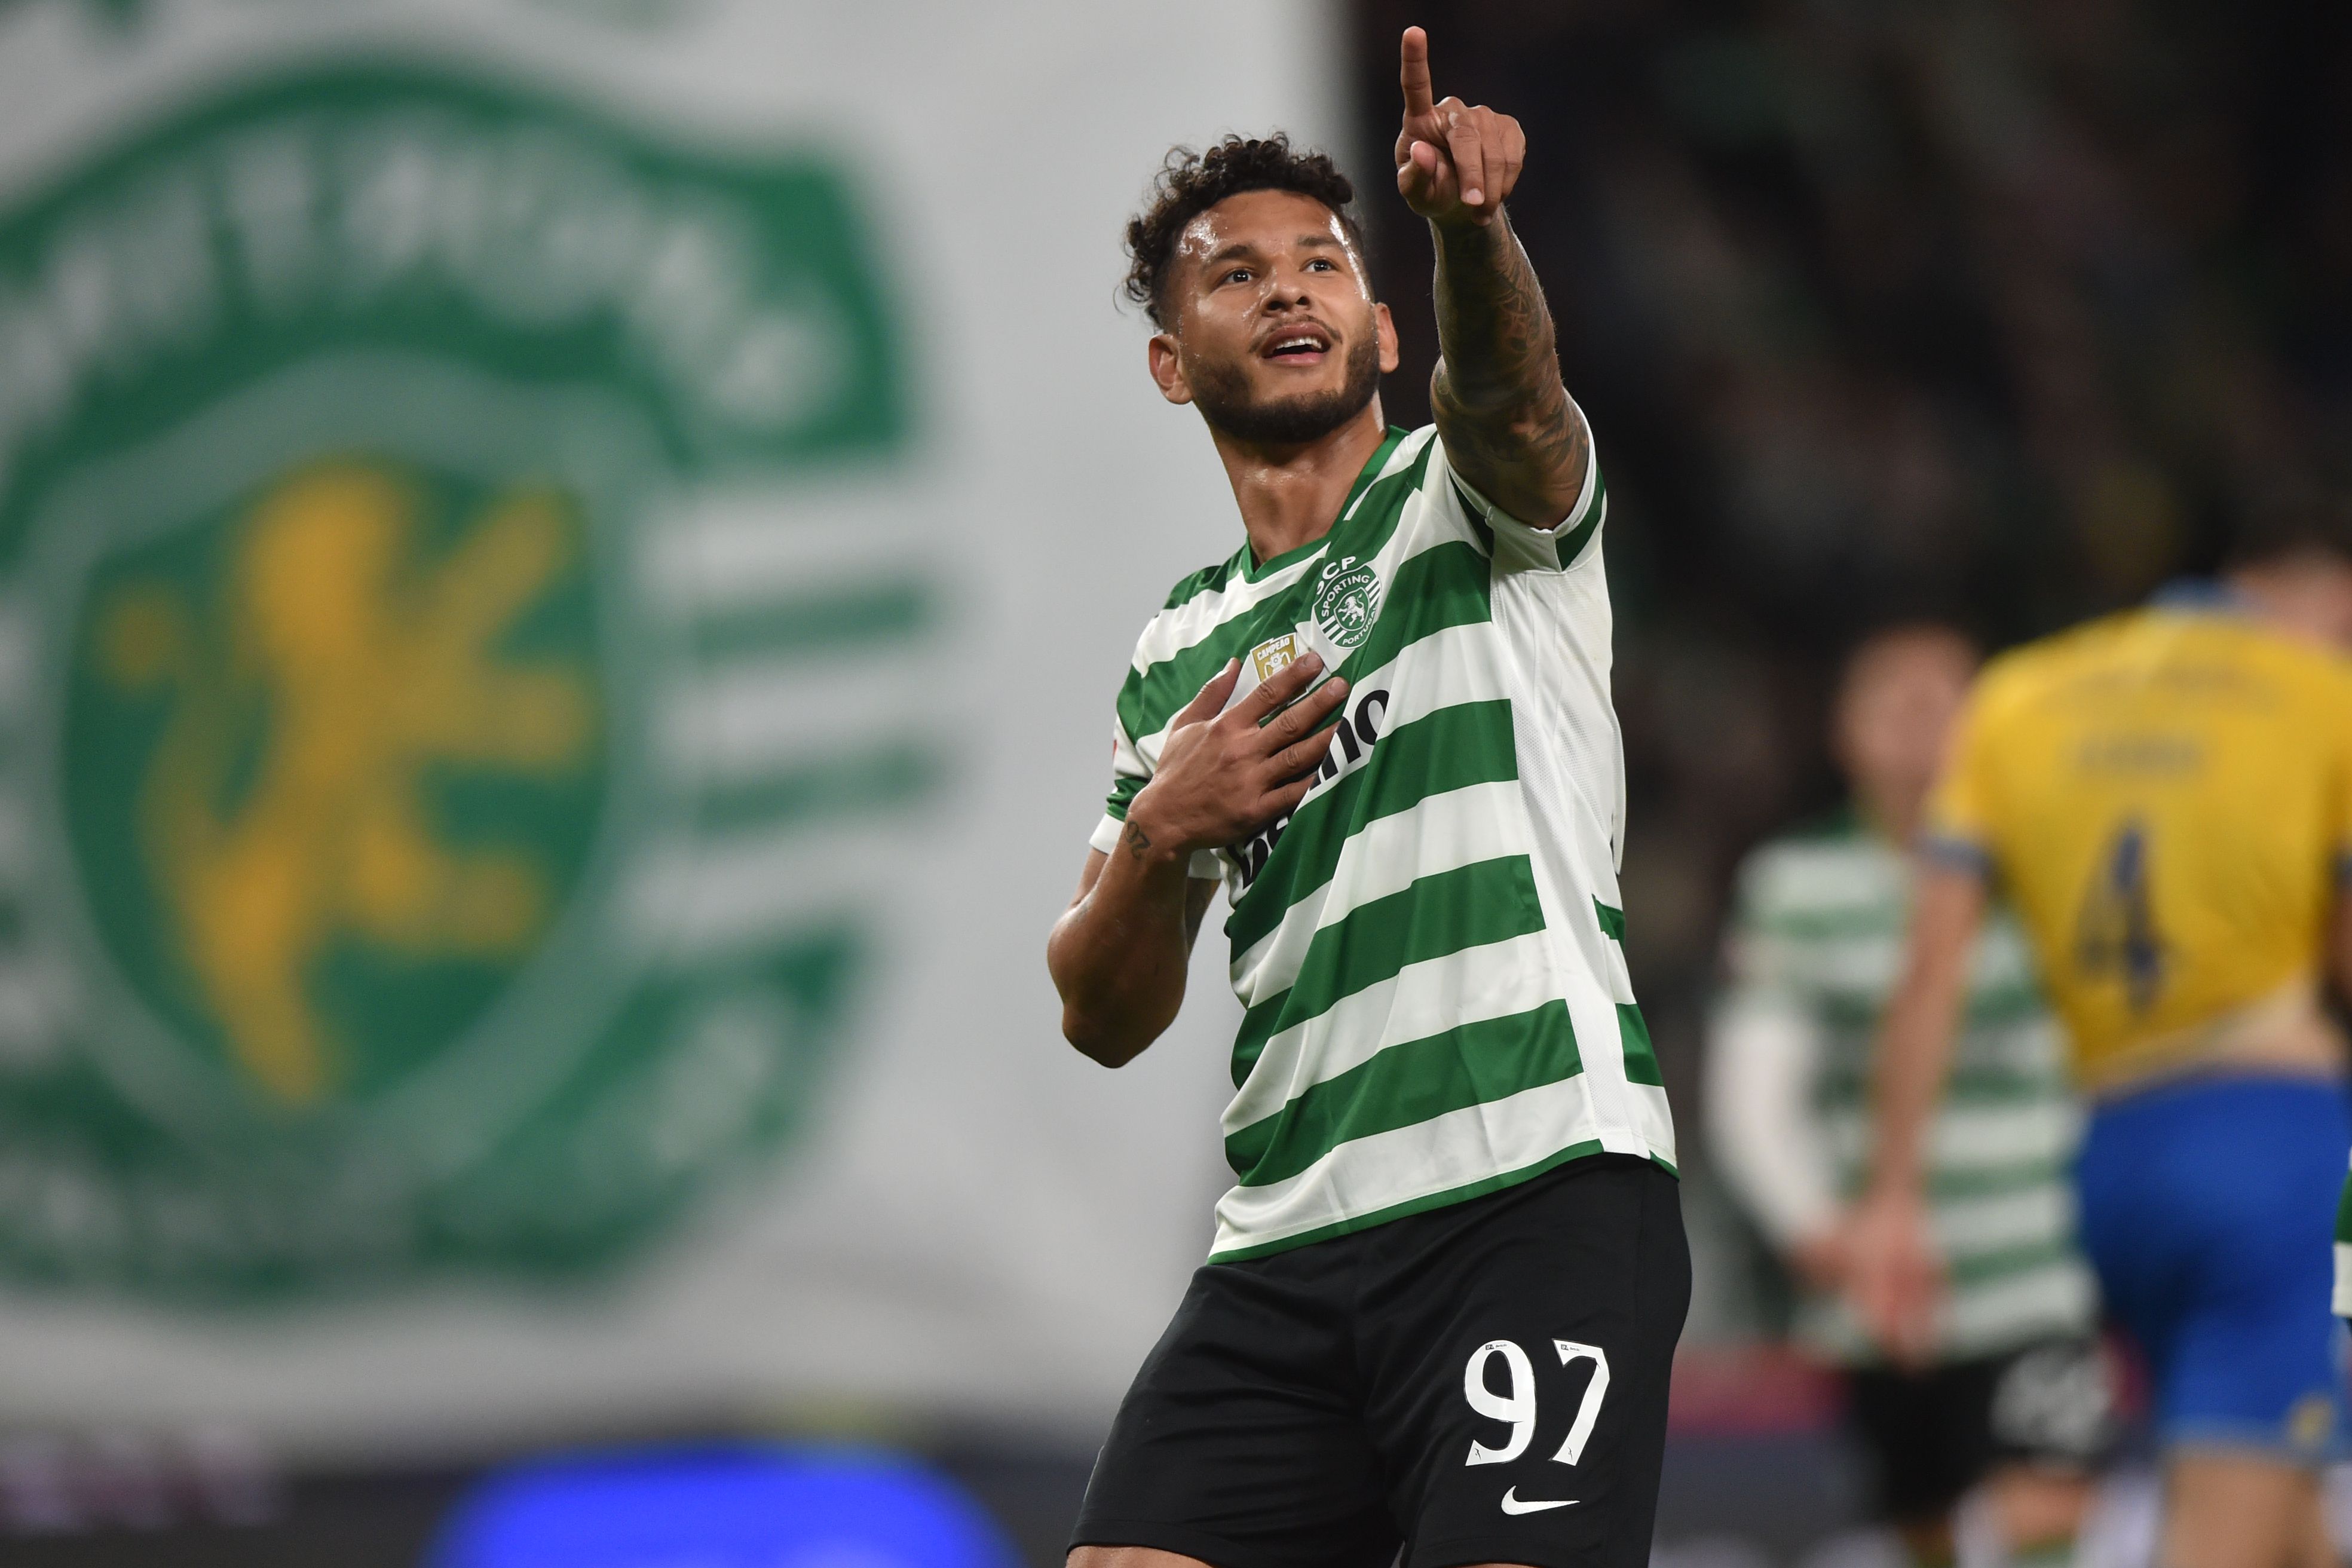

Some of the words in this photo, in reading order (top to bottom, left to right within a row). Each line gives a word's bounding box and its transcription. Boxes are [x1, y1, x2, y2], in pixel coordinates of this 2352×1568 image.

[1321, 574, 1370, 617] SPORTING
[1342, 607, 1377, 645] PORTUGA
[1464, 1339, 1610, 1466] 97
